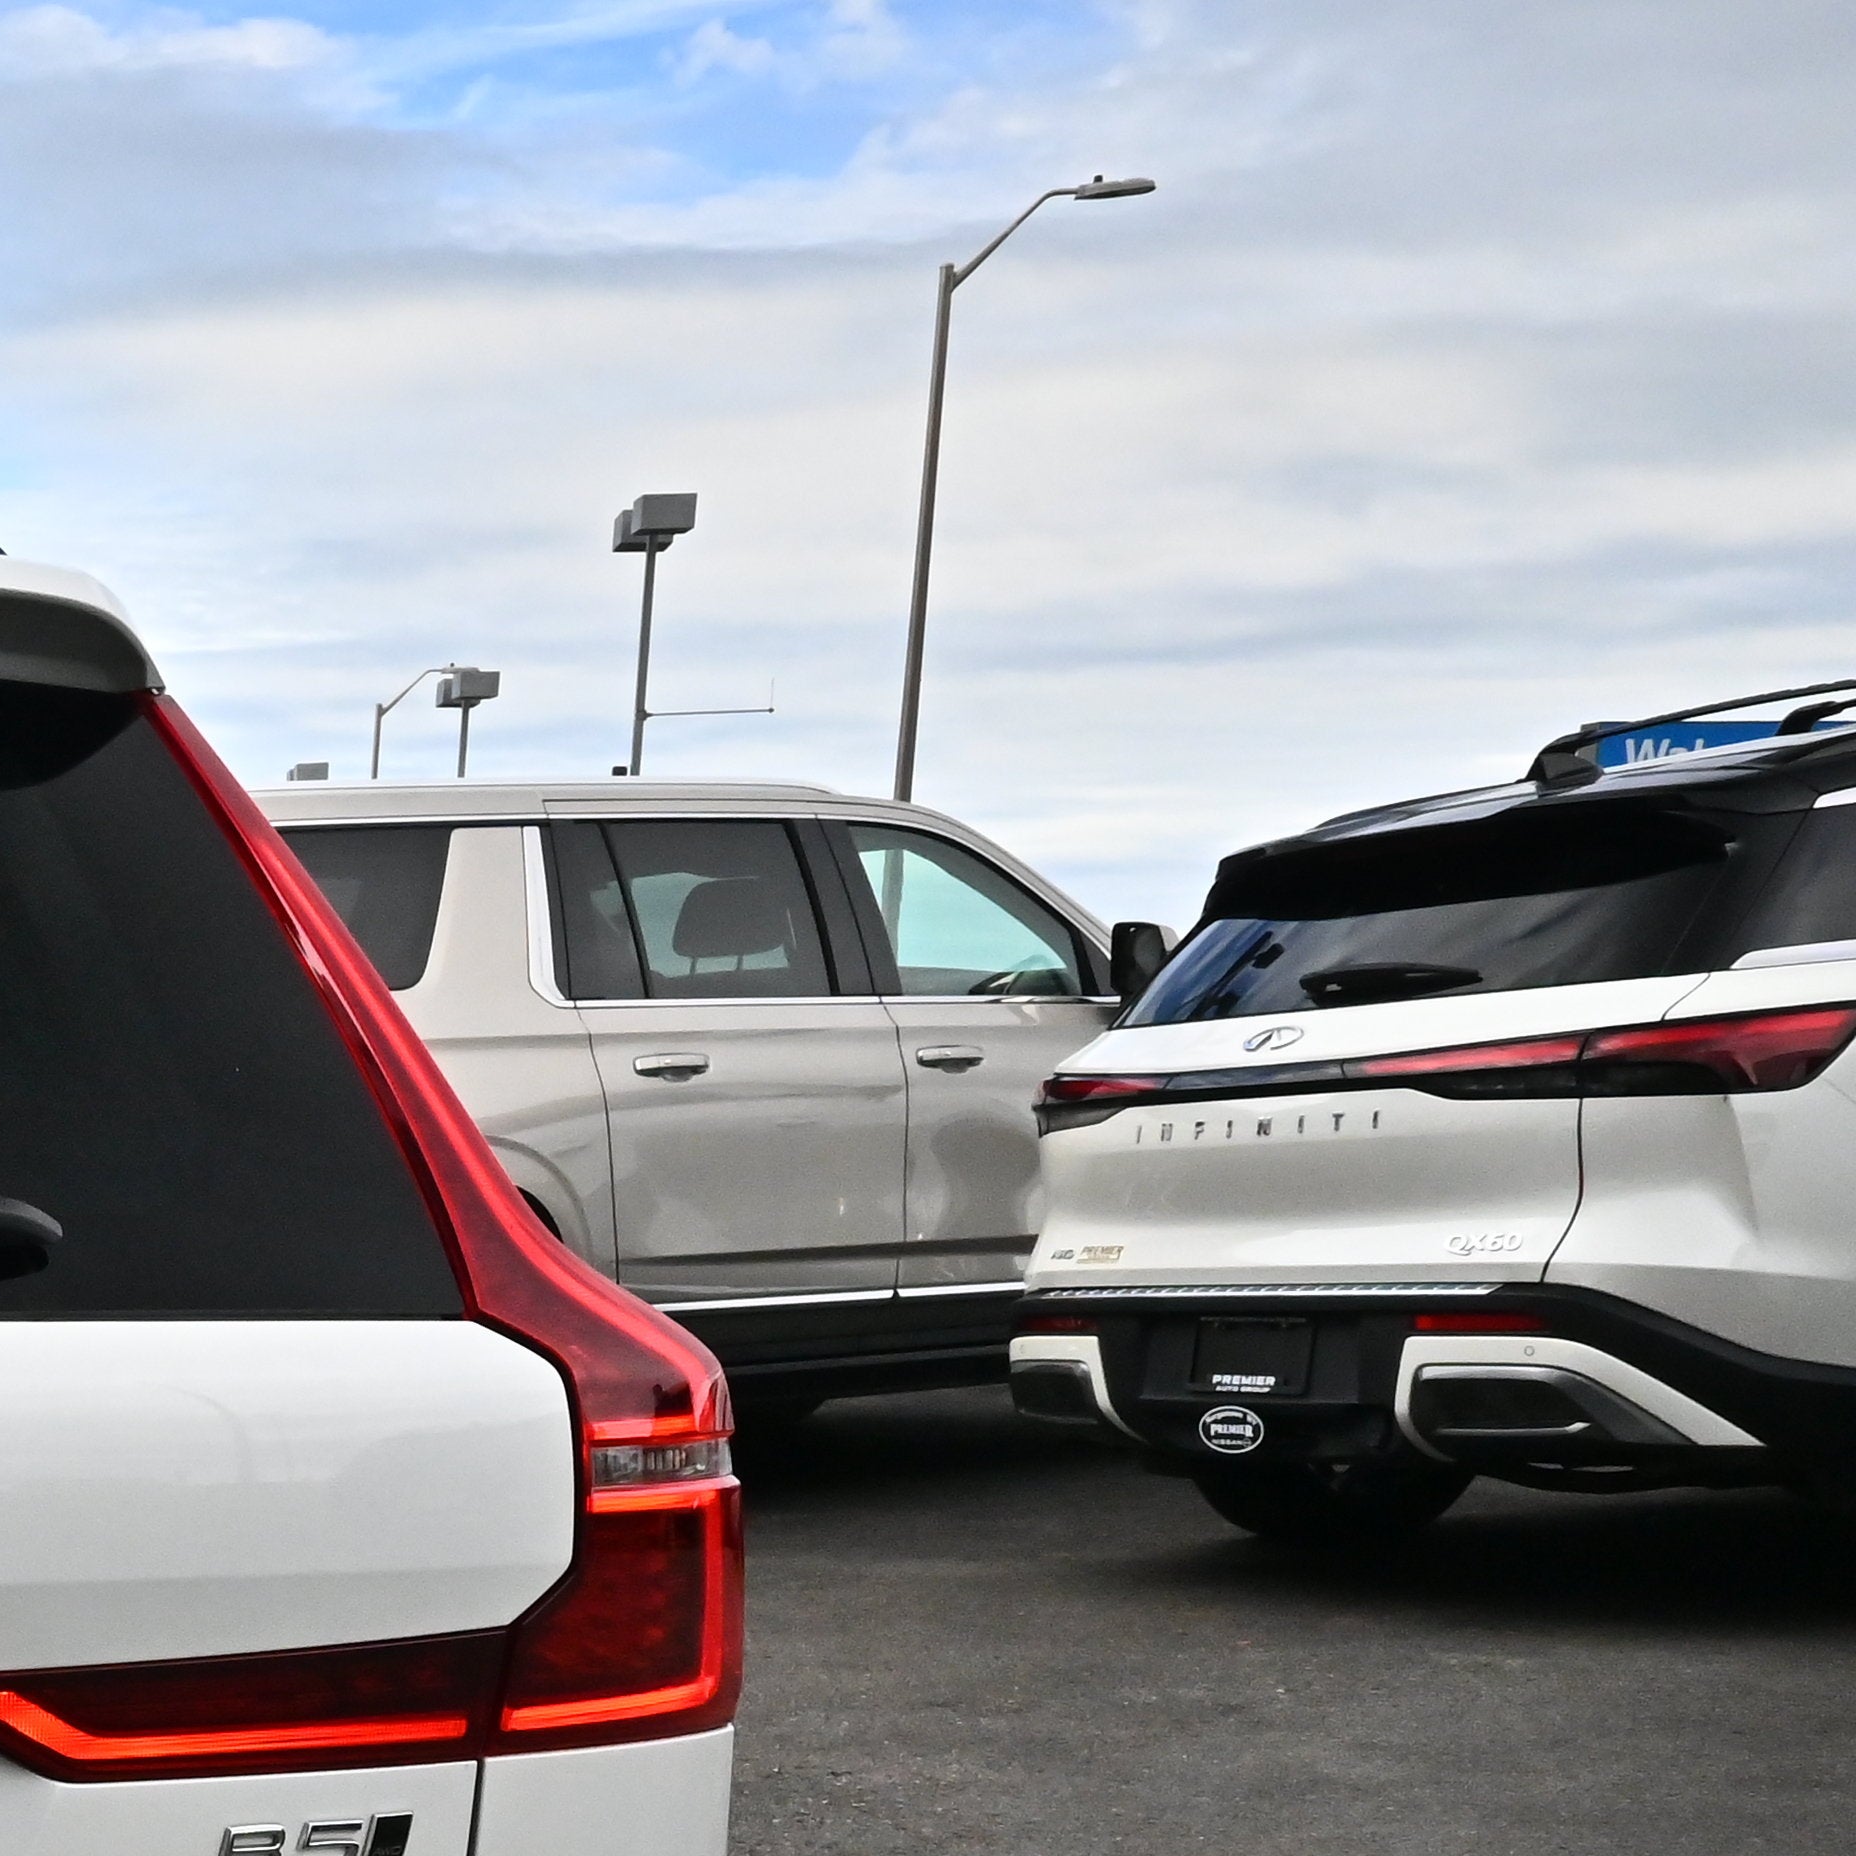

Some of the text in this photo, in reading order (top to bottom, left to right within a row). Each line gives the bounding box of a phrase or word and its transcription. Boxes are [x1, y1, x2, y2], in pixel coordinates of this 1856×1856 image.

[1136, 1110, 1381, 1144] INFINITI
[1445, 1232, 1523, 1257] QX60
[1212, 1374, 1276, 1386] PREMIER
[1210, 1424, 1254, 1437] PREMIER
